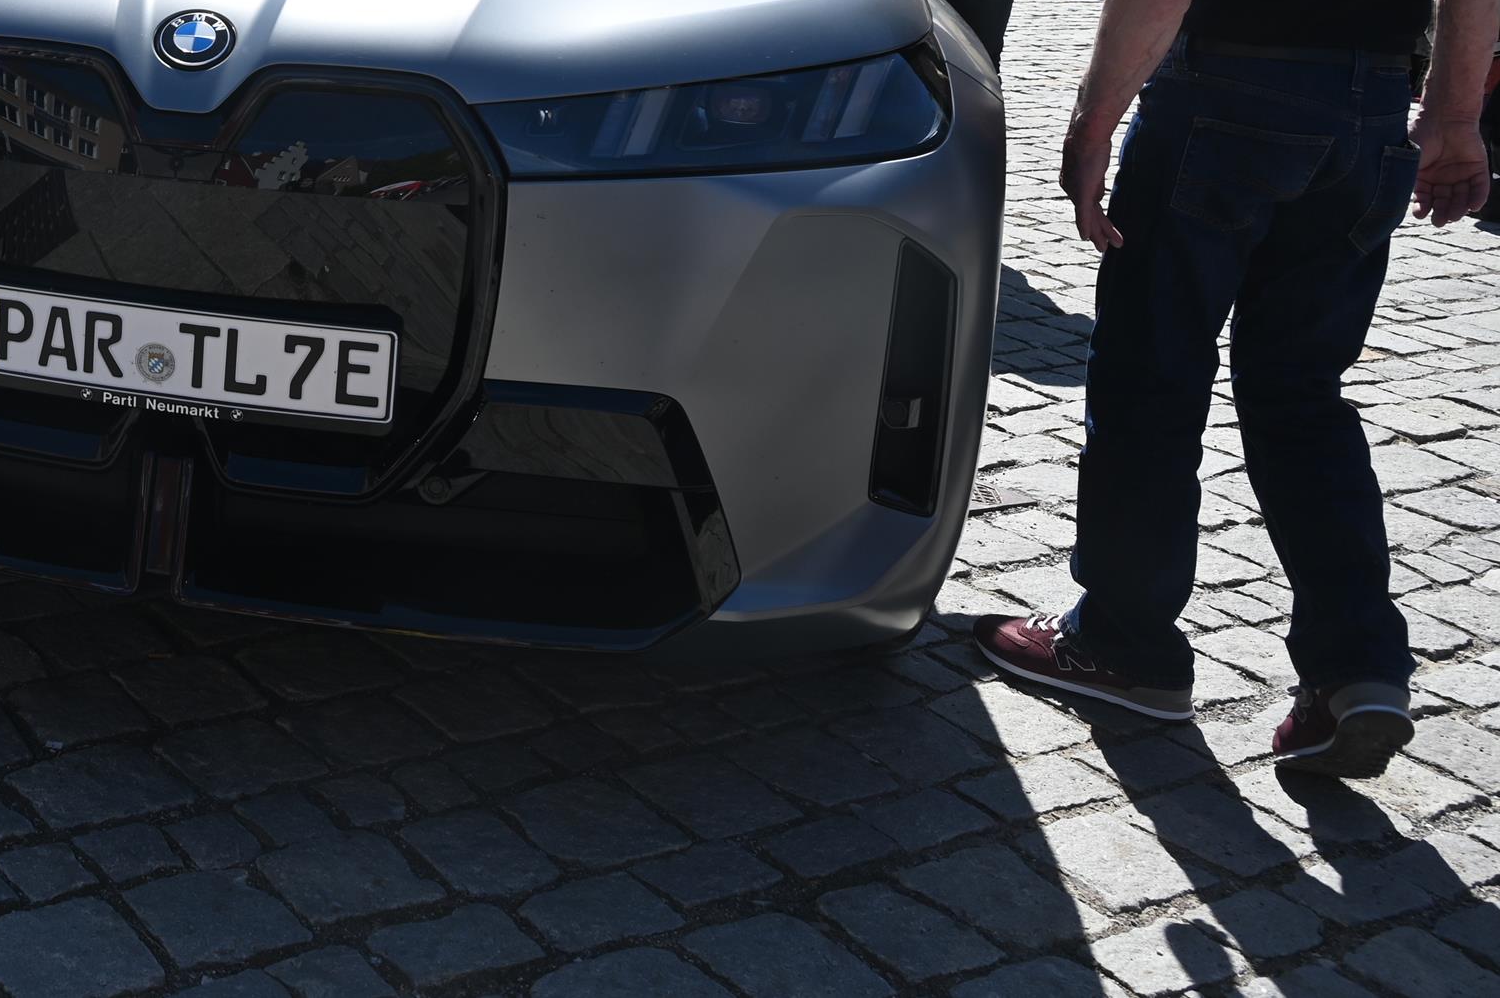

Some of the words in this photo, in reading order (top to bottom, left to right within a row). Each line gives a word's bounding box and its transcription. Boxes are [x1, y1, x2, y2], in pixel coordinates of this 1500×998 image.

[171, 14, 227, 31] BMW
[102, 391, 137, 408] Partl
[145, 397, 220, 419] Neumarkt
